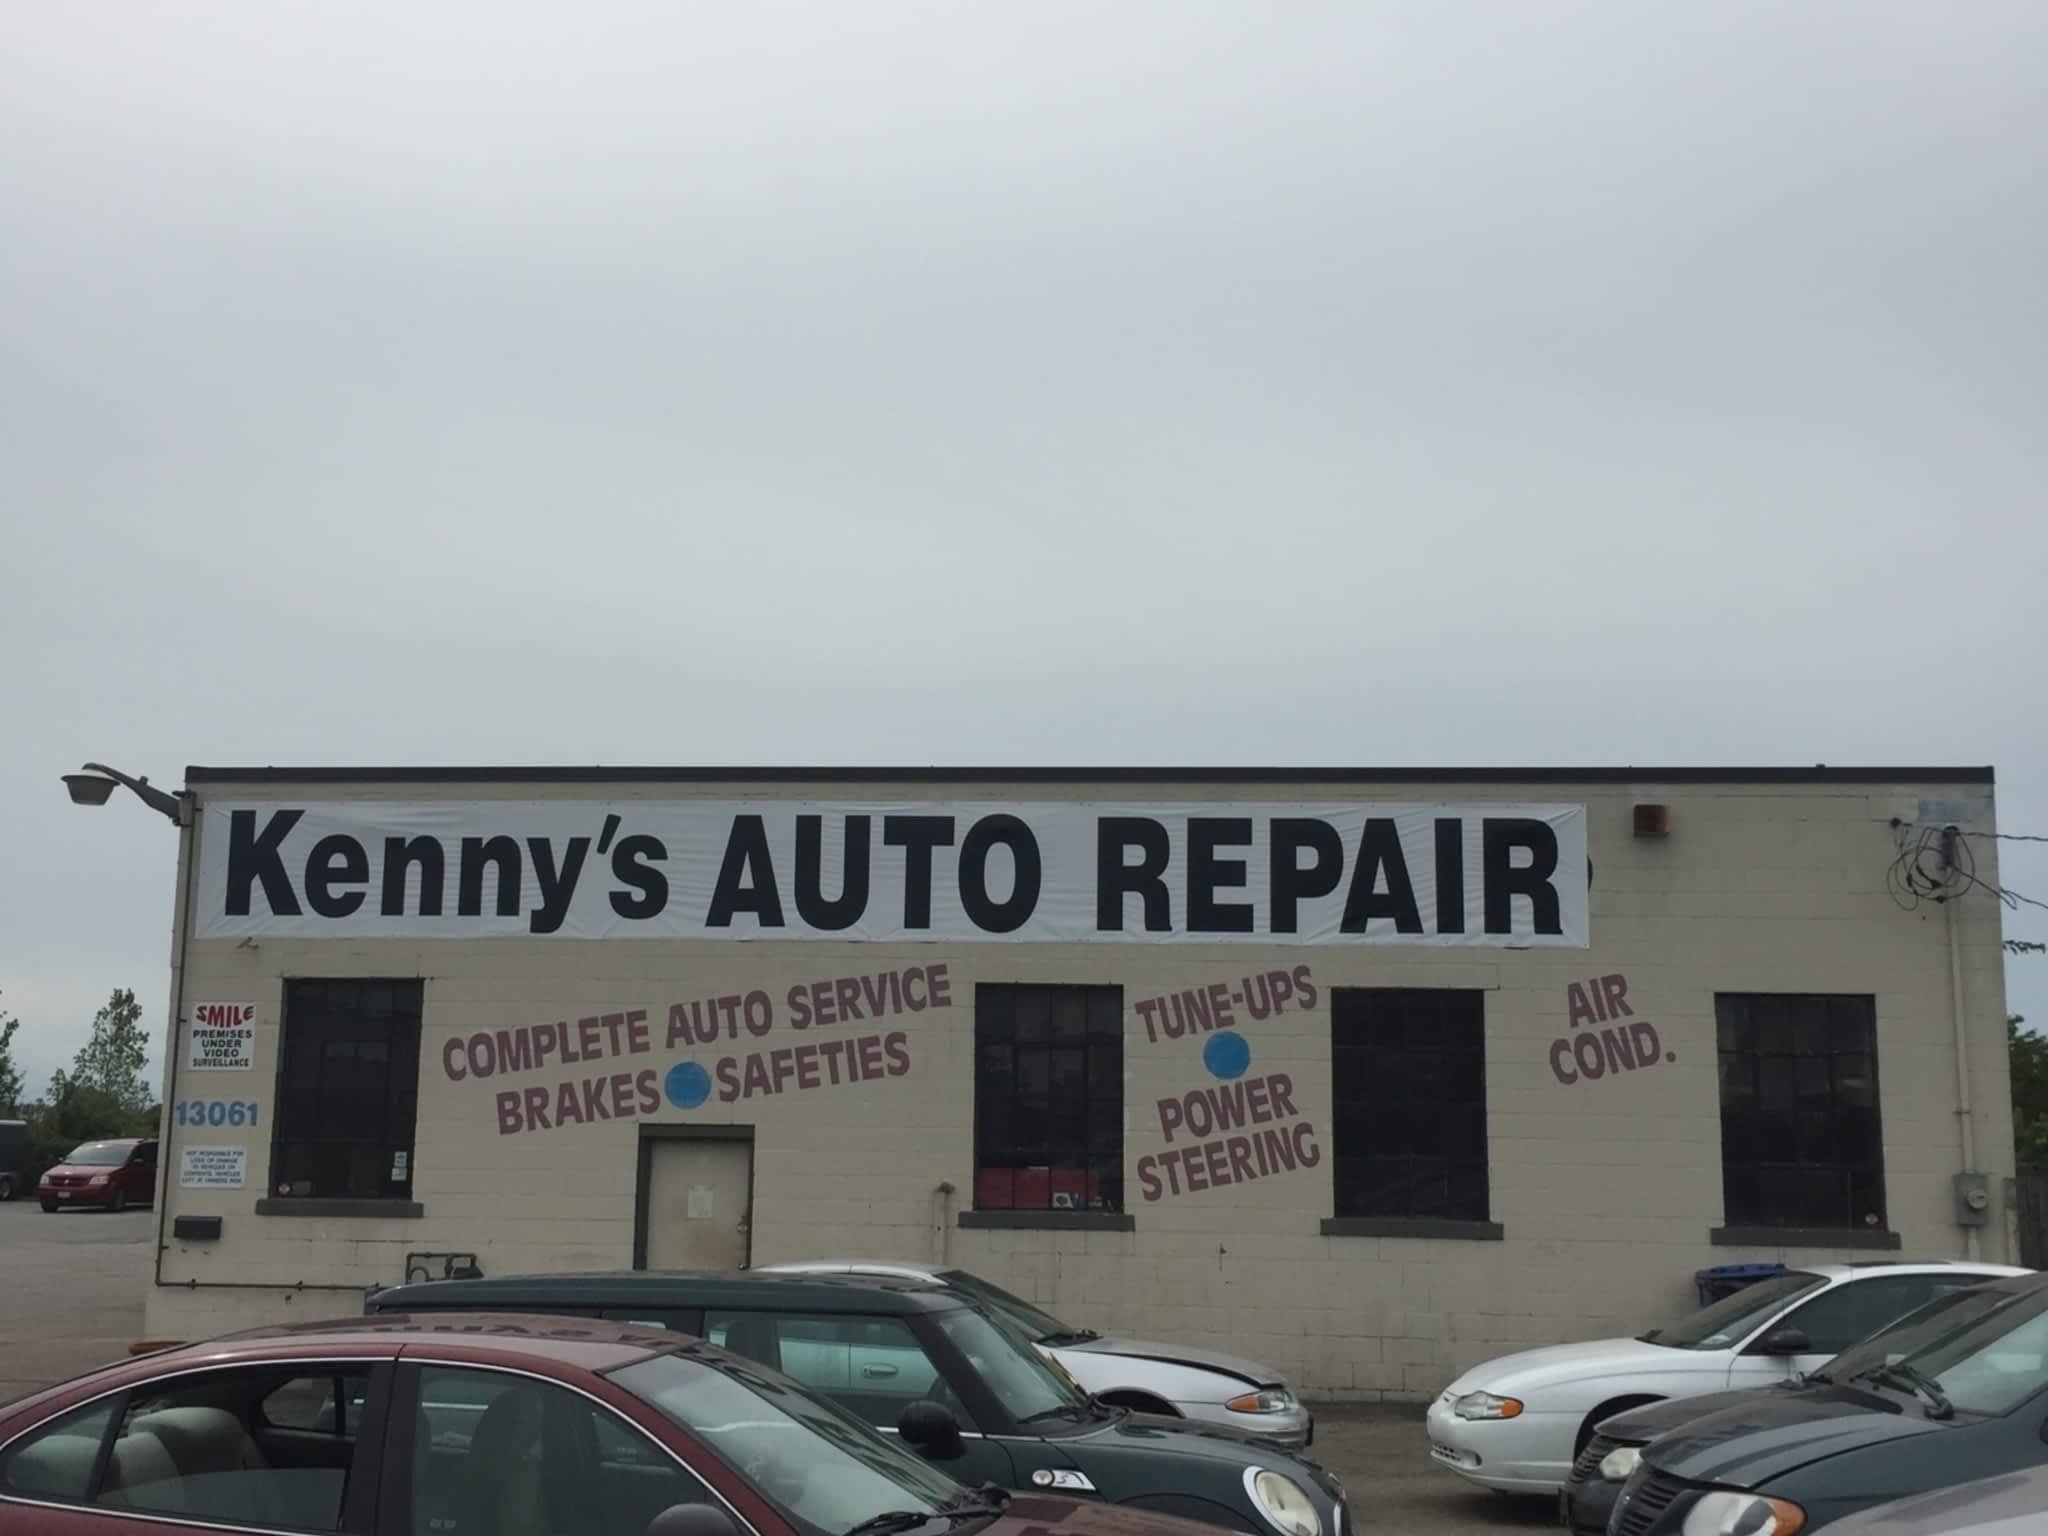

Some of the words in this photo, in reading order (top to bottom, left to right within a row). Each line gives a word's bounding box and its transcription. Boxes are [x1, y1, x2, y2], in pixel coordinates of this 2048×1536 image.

[224, 809, 669, 934] Kenny's
[704, 813, 1042, 934] AUTO
[1096, 815, 1564, 936] REPAIR
[196, 1005, 254, 1028] SMILE
[442, 1008, 651, 1082] COMPLETE
[665, 990, 773, 1049] AUTO
[787, 963, 952, 1031] SERVICE
[1135, 965, 1318, 1043] TUNE-UPS
[1567, 973, 1635, 1028] AIR
[192, 1029, 253, 1039] PREMISES
[192, 1057, 249, 1068] SURVEILLANCE
[201, 1039, 242, 1049] UNDER
[203, 1048, 239, 1058] VIDEO
[1549, 1021, 1677, 1086] COND.
[496, 1068, 662, 1135] BRAKES
[715, 1031, 911, 1102] SAFETIES
[1157, 1073, 1299, 1143] POWER
[176, 1101, 258, 1127] 13061
[1136, 1122, 1321, 1202] STEERING
